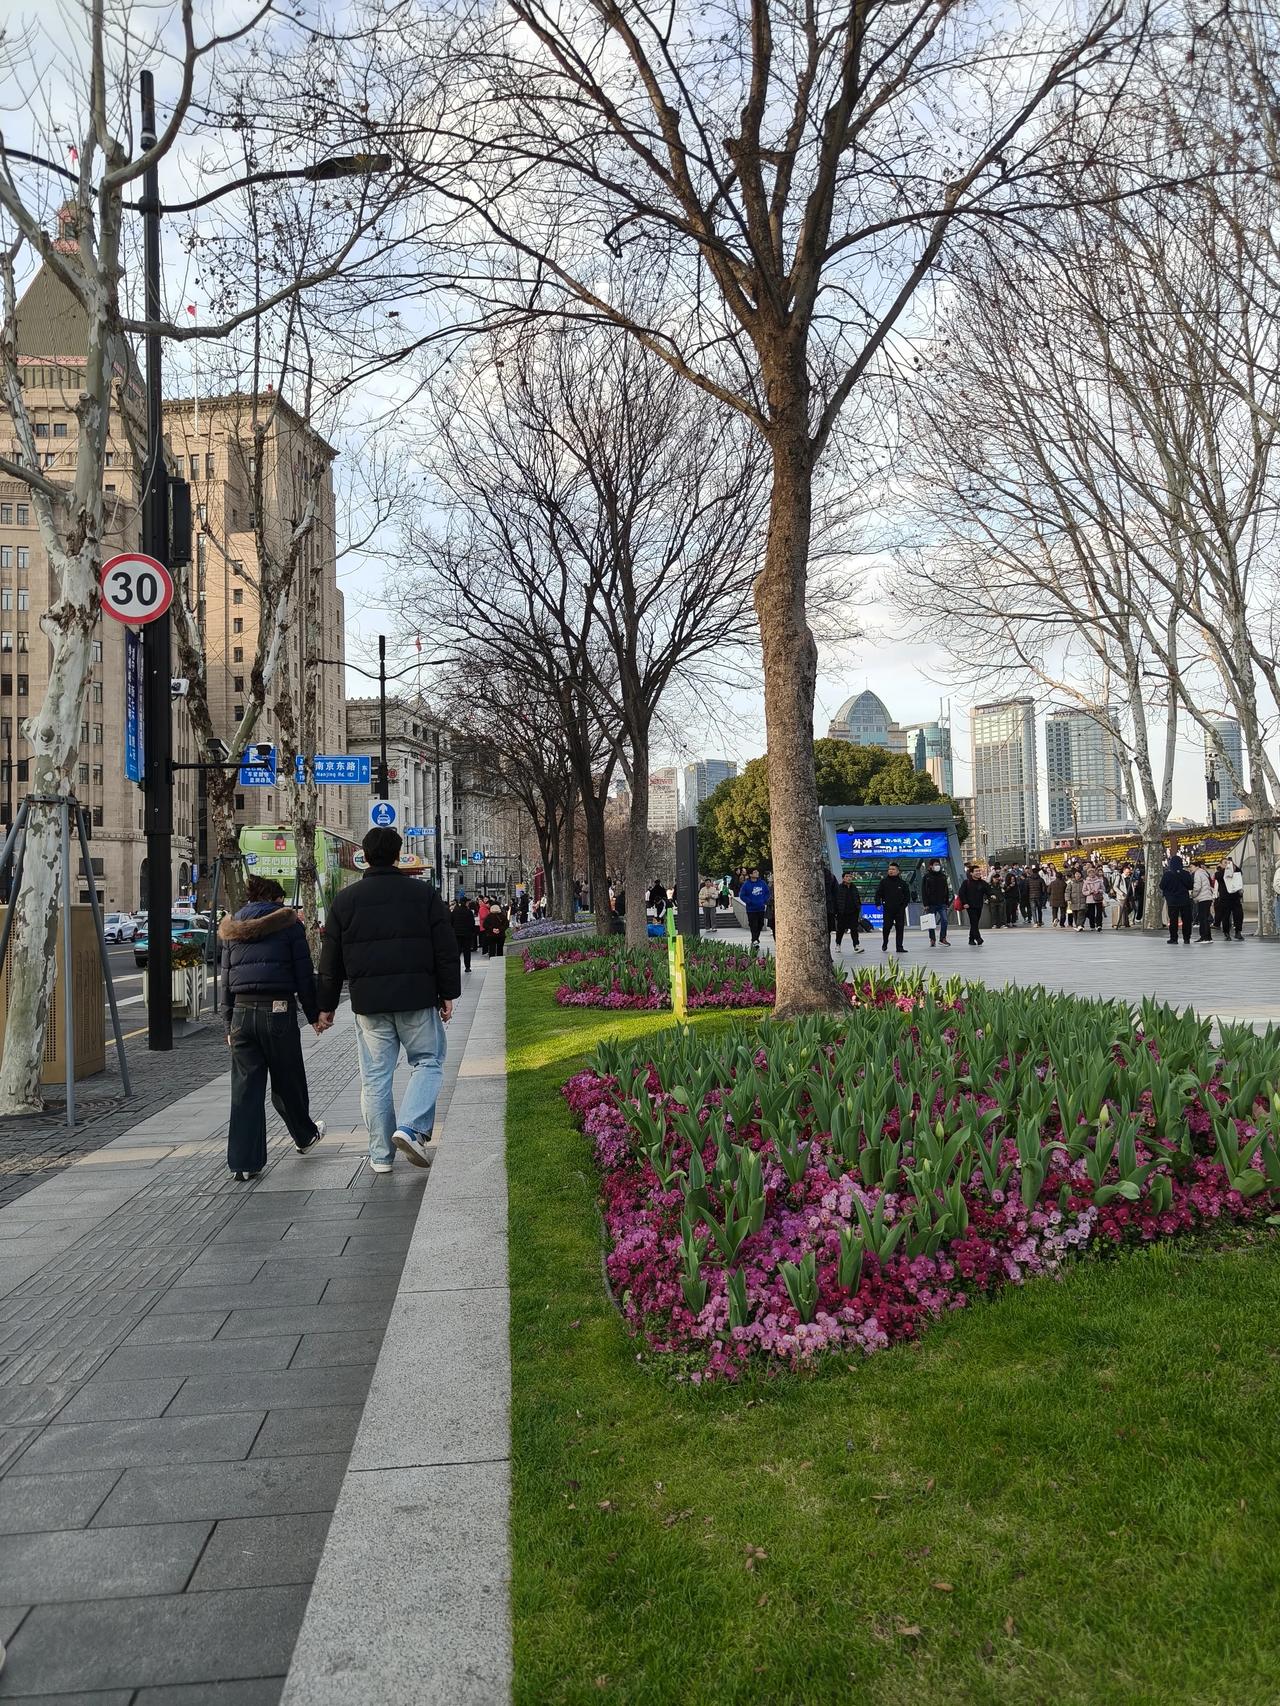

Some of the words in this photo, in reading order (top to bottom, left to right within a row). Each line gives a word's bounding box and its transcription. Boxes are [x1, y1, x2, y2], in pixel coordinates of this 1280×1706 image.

[111, 571, 158, 605] 30
[315, 761, 356, 771] 南京东路
